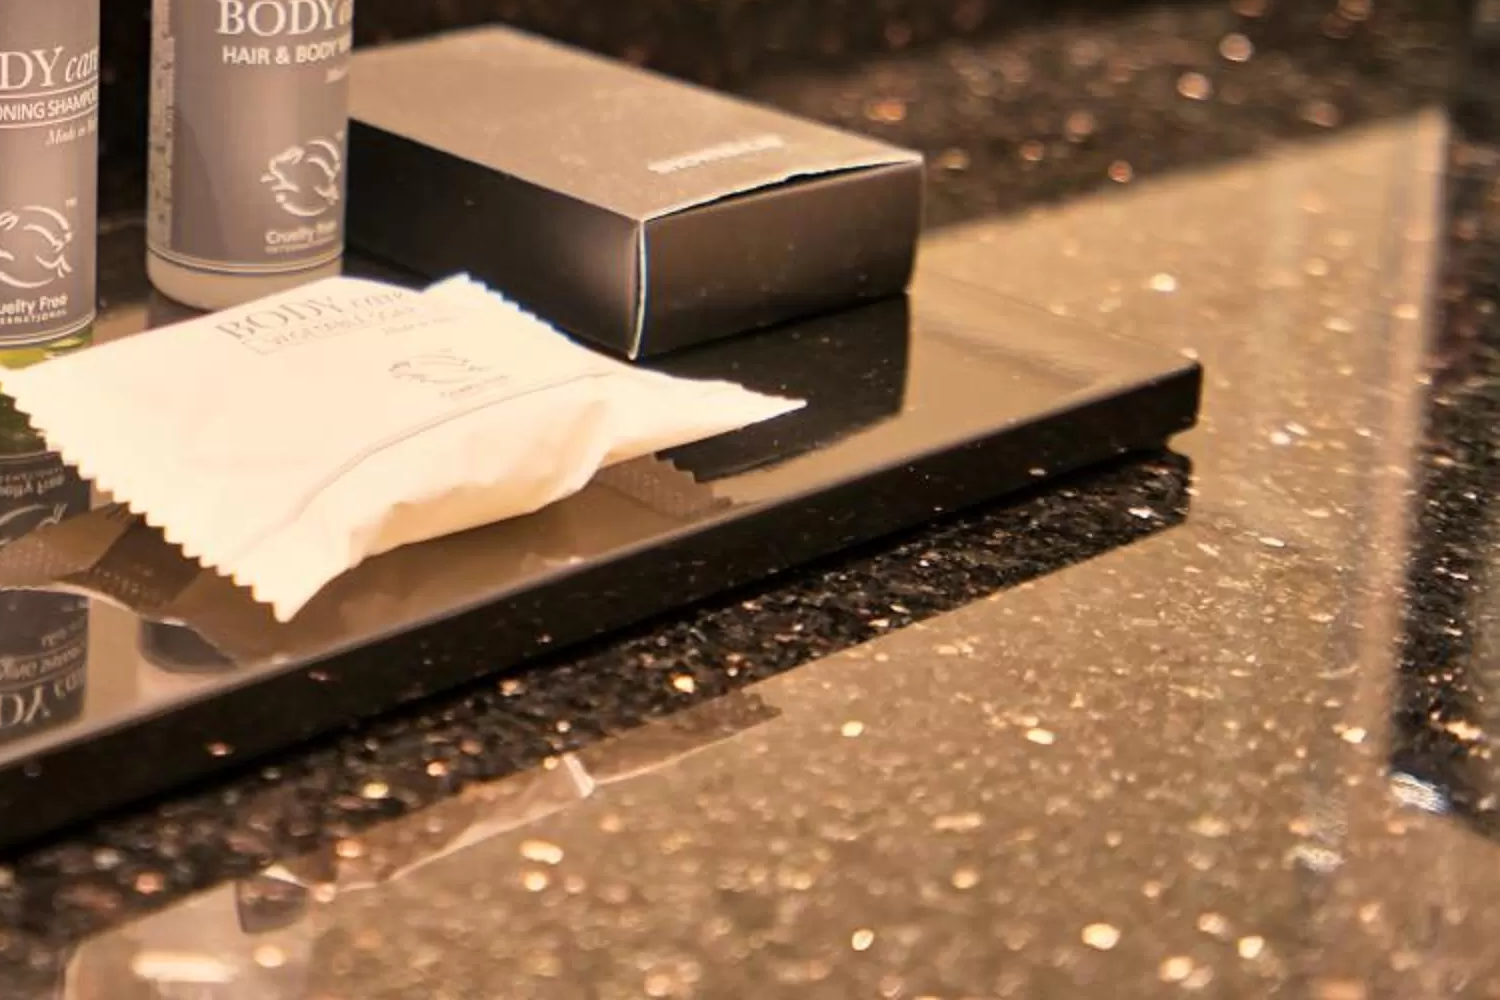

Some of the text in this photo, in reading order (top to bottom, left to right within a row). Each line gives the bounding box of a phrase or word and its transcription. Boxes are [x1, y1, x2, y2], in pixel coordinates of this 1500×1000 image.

[221, 45, 270, 66] HAIR
[275, 46, 291, 66] &
[295, 40, 336, 64] BODY
[39, 292, 69, 311] Free
[214, 294, 344, 341] BODY
